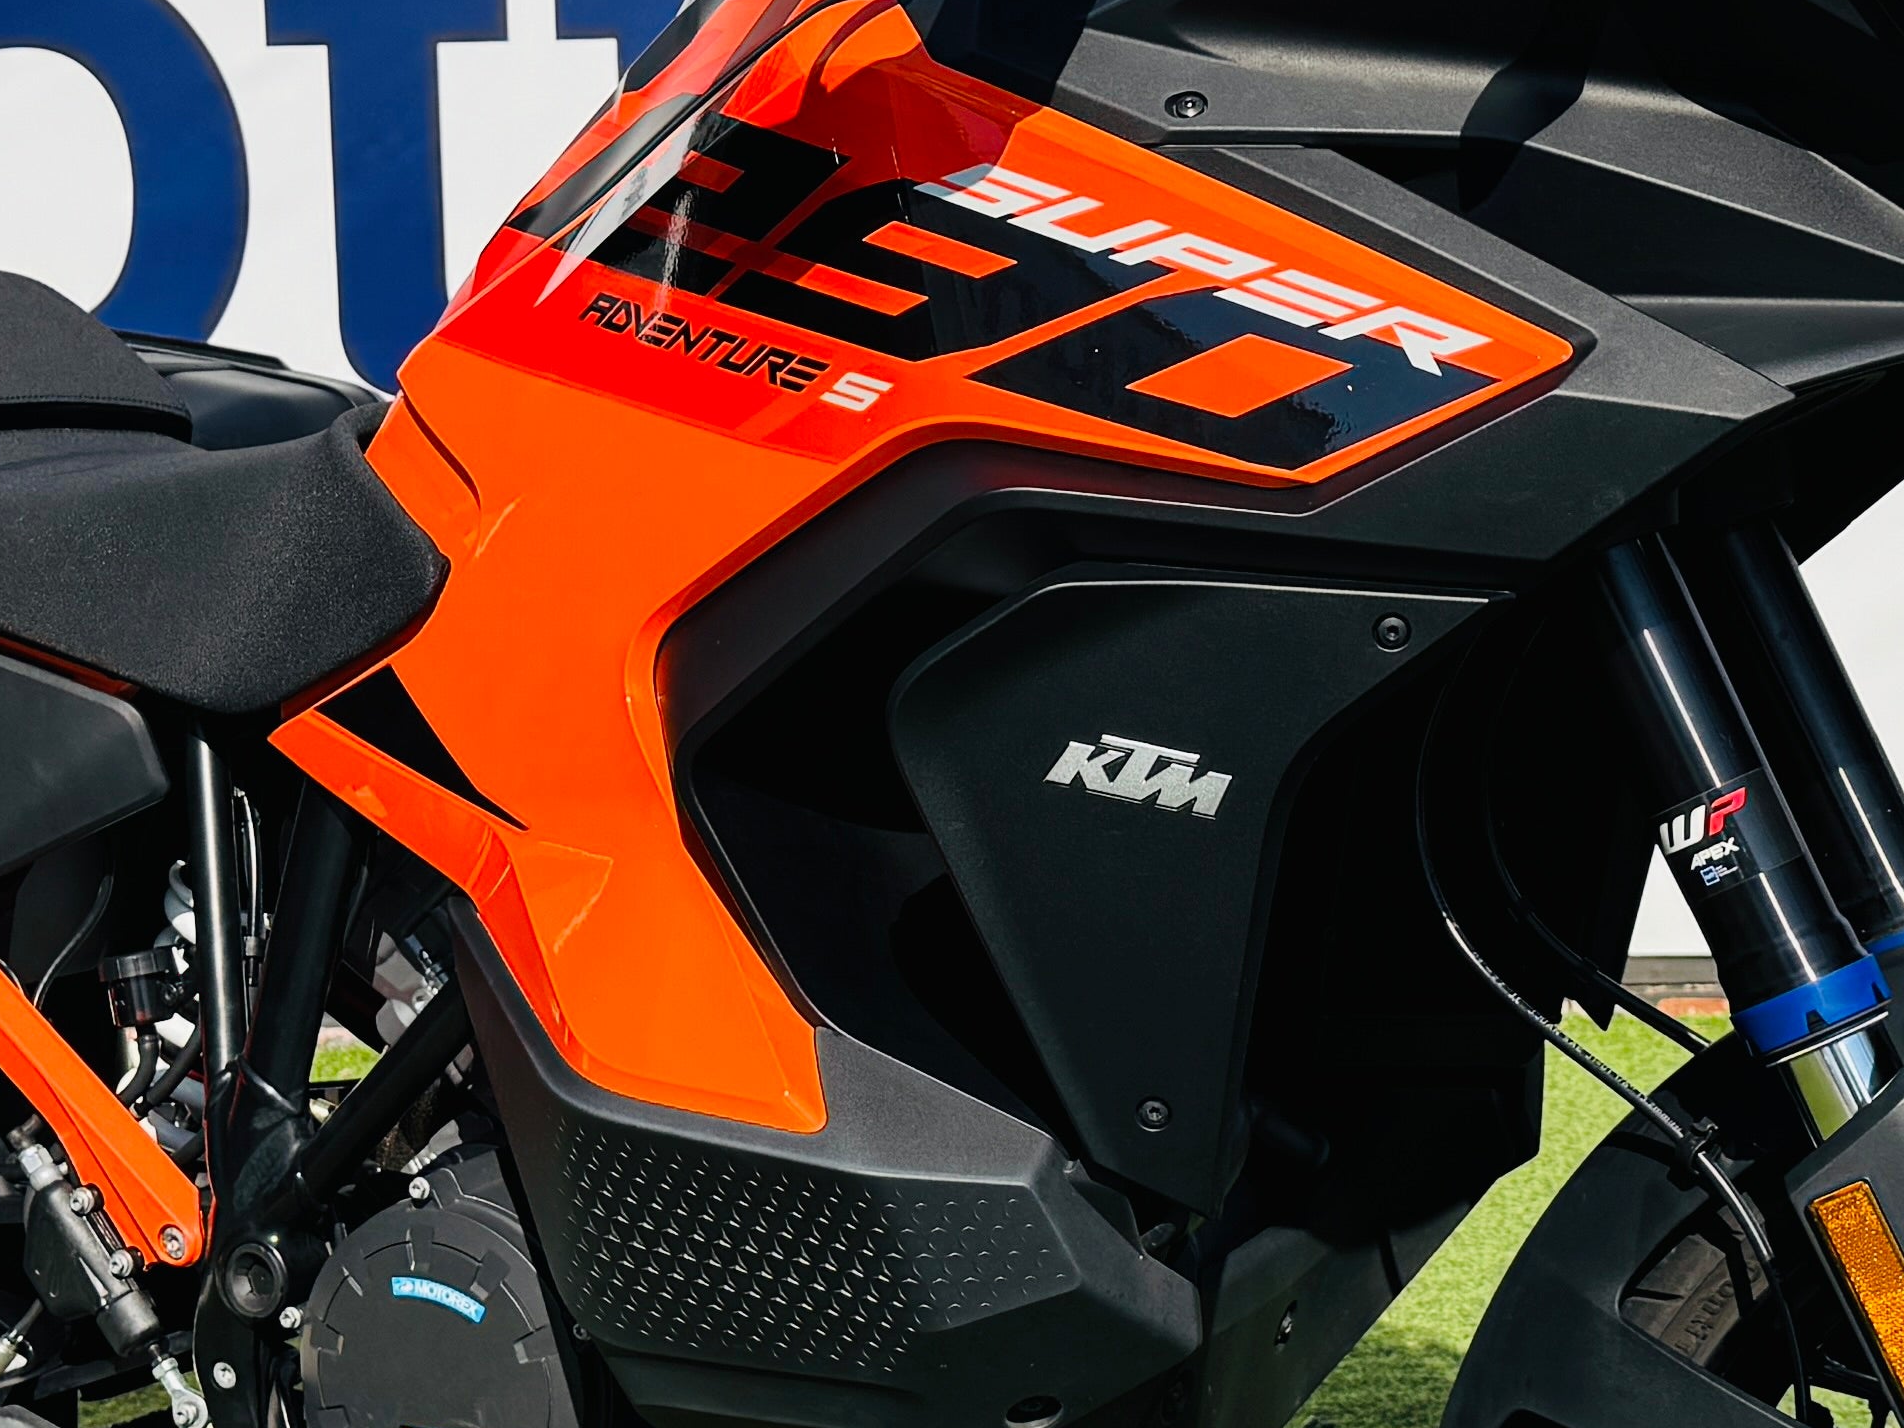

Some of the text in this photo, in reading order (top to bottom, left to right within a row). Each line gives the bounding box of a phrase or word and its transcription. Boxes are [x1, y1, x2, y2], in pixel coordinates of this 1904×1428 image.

[913, 163, 1493, 378] SUPER
[578, 292, 895, 412] ADVENTURE S
[1043, 733, 1233, 821] KTM
[1659, 786, 1747, 856] WP
[1690, 836, 1740, 871] APEX
[412, 1278, 480, 1317] MOTOREX
